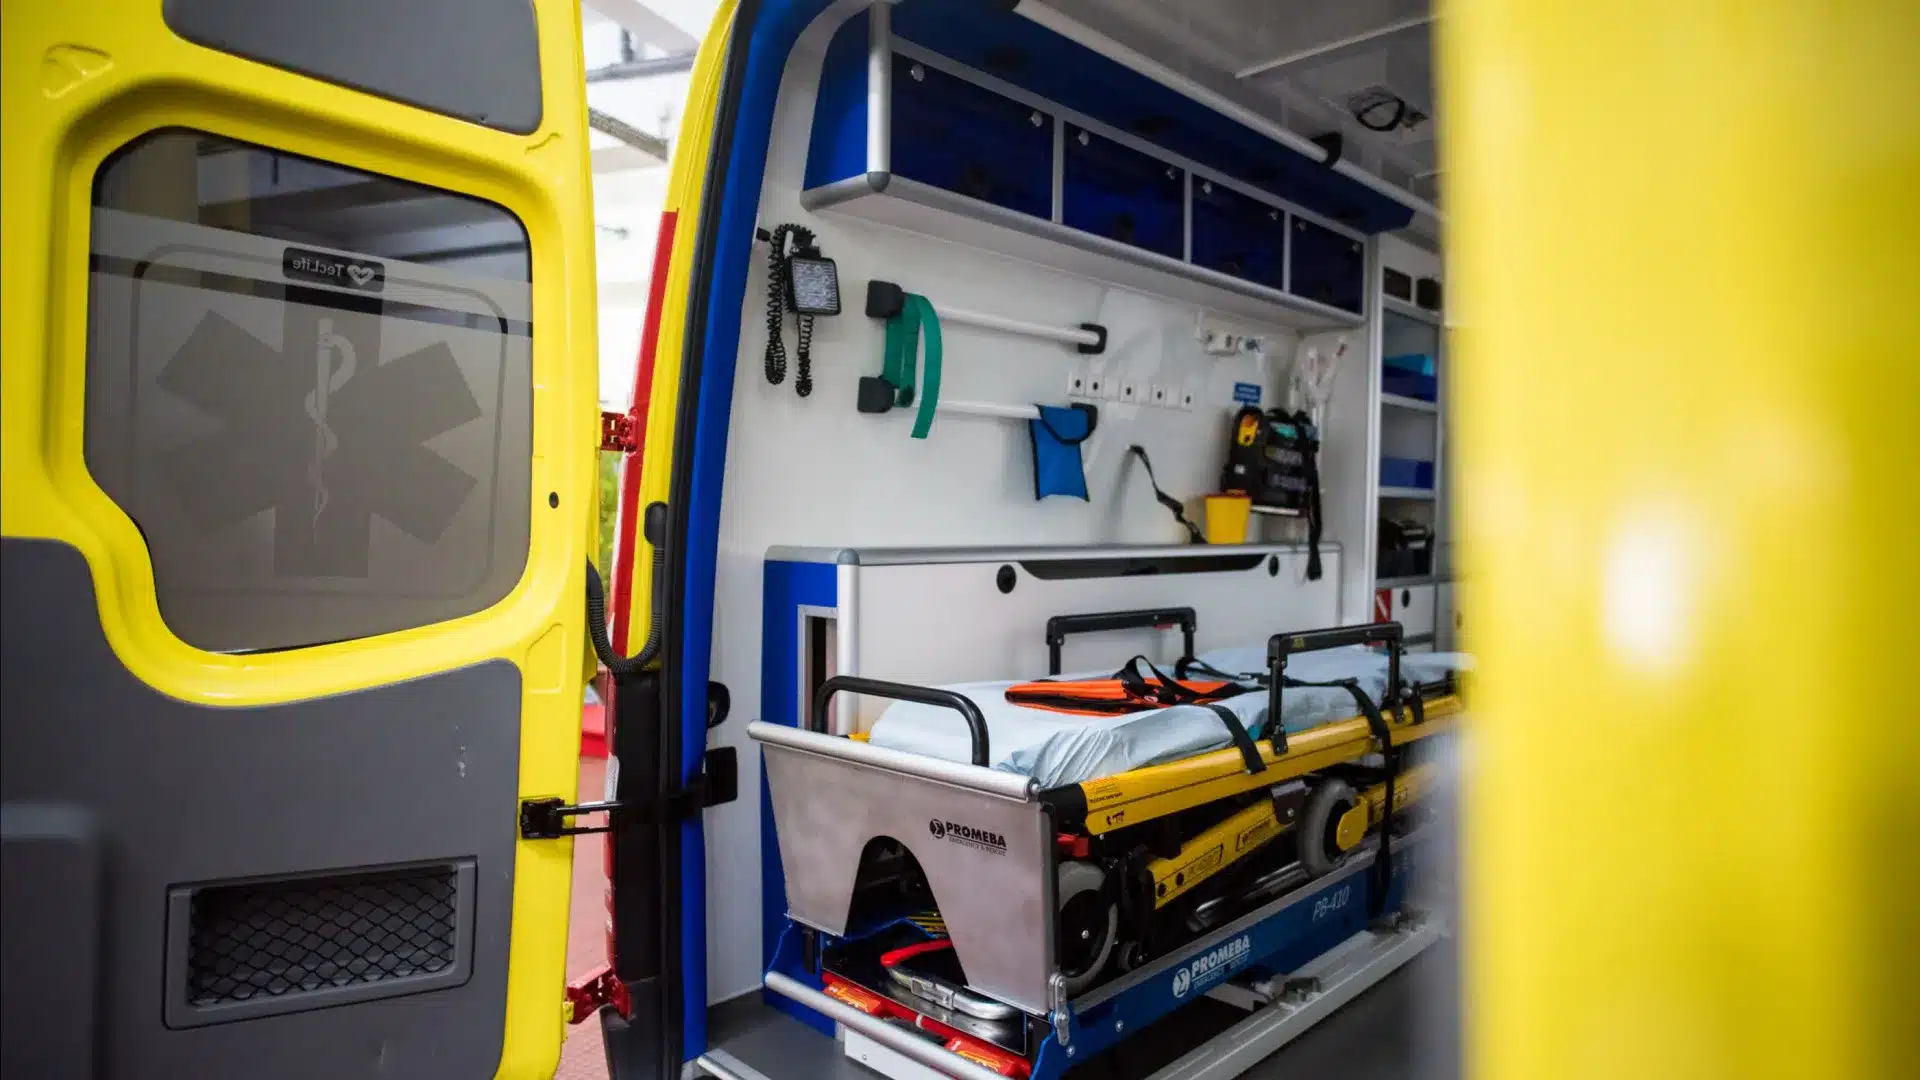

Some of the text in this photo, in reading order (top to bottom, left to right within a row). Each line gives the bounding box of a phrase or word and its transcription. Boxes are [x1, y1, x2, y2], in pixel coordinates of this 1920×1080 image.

[945, 821, 1007, 848] PROMEBA
[1312, 885, 1350, 922] PB-410
[1191, 934, 1250, 978] PROMEBA
